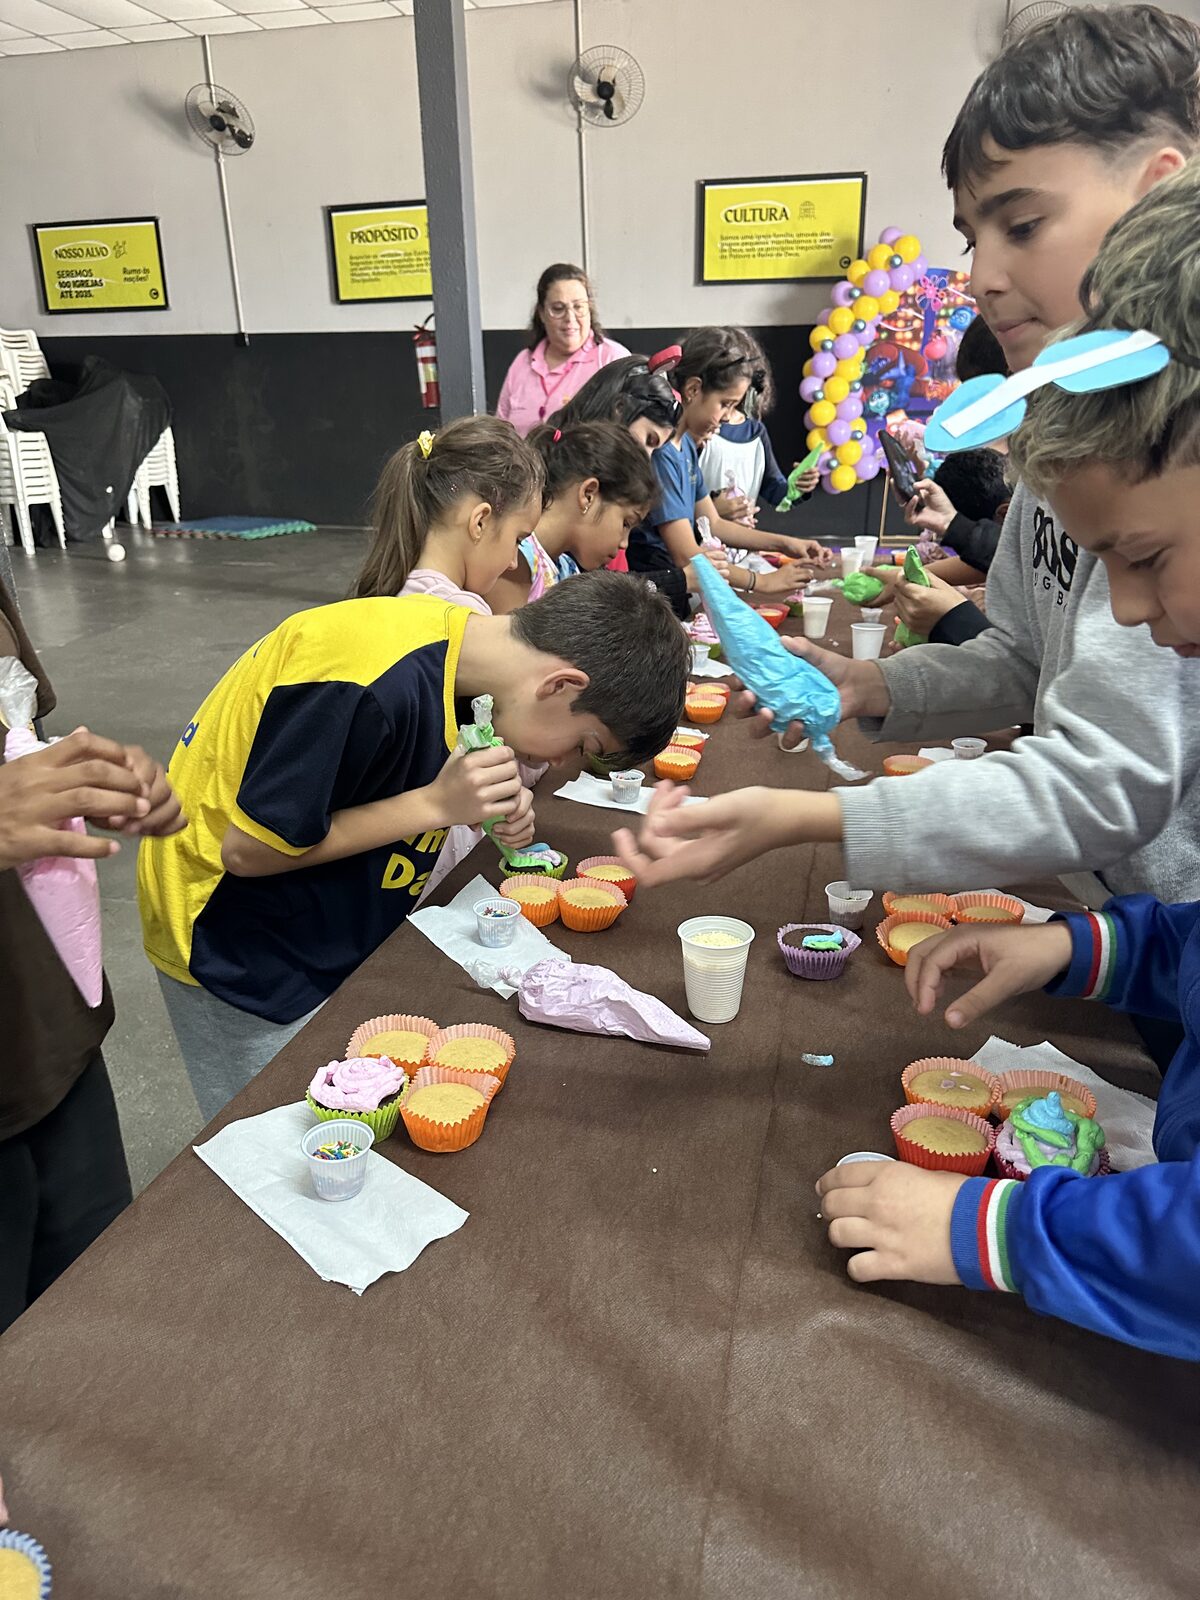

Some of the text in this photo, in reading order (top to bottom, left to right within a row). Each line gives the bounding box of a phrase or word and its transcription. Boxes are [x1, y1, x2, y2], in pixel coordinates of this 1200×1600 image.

[724, 207, 789, 223] CULTURA
[350, 225, 419, 244] PROPÓSITO
[54, 246, 109, 259] NOSSO ALVO
[56, 269, 94, 279] SEREMOS
[72, 278, 104, 288] IGREJAS
[60, 288, 73, 299] ATÉ
